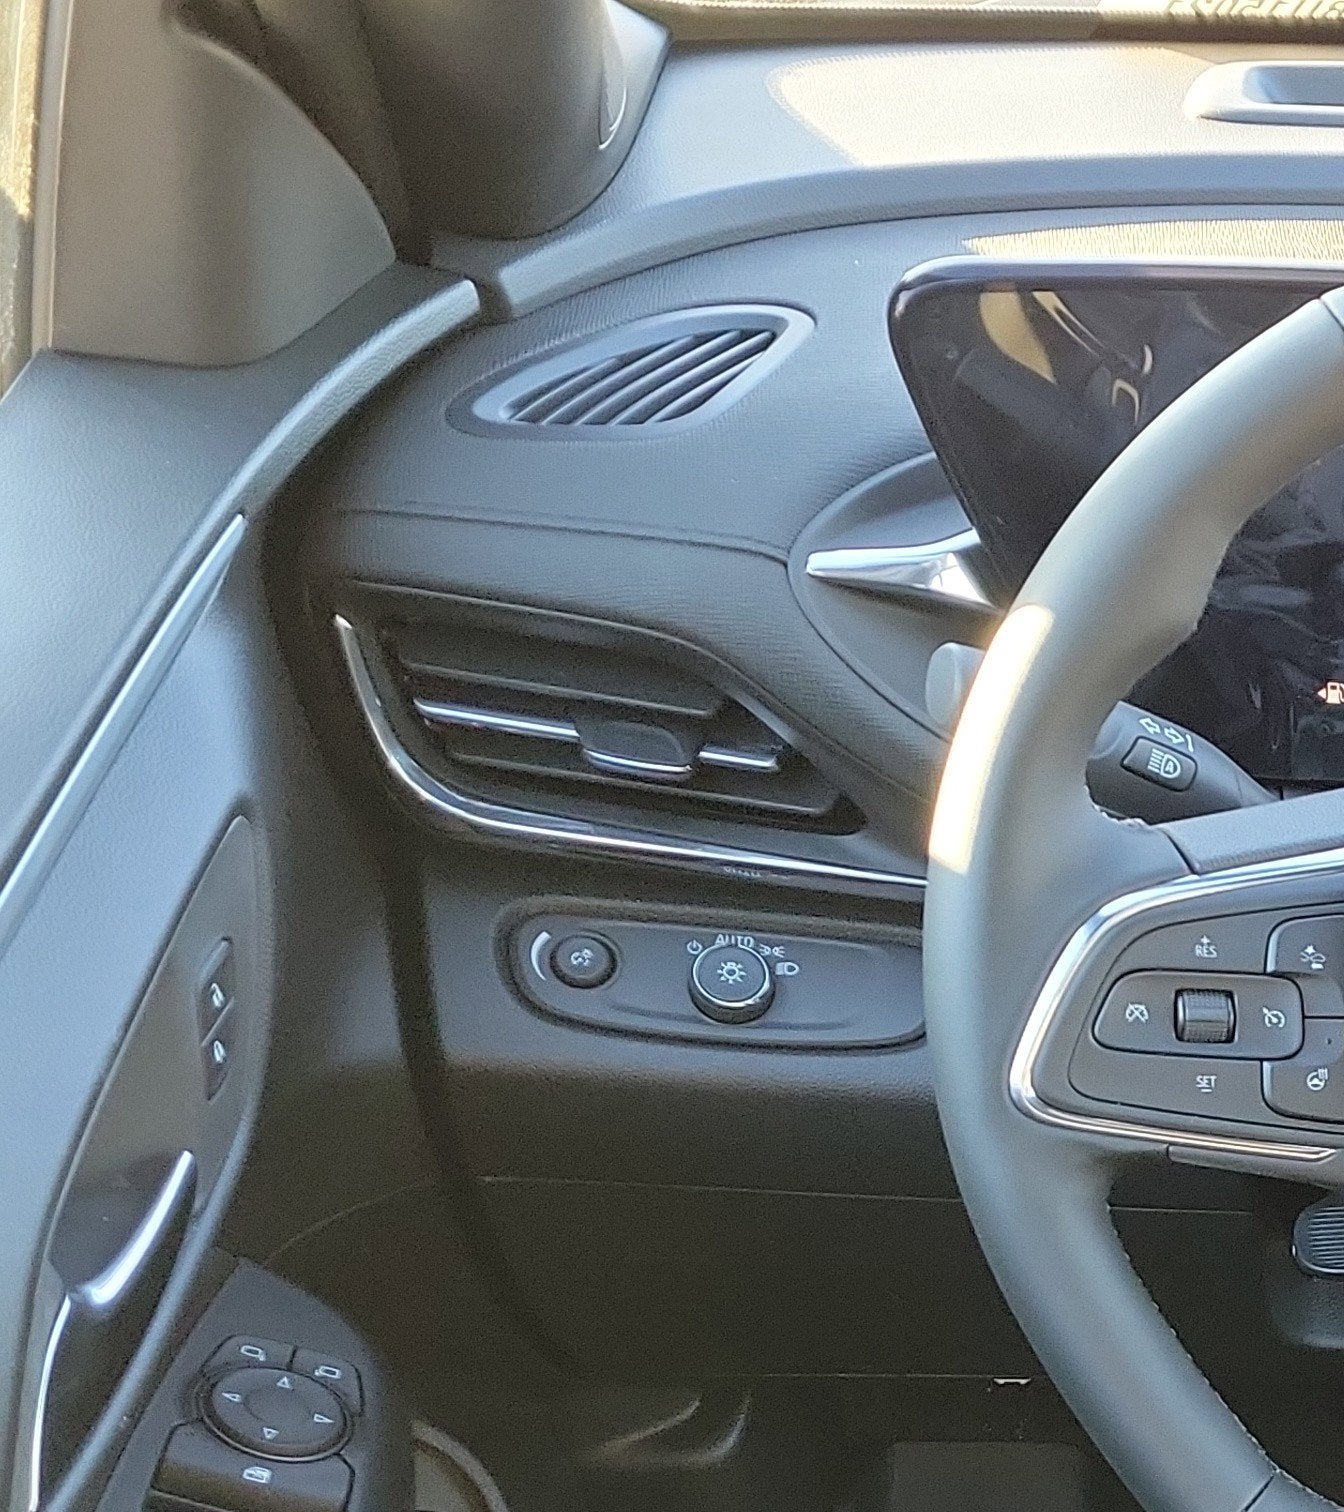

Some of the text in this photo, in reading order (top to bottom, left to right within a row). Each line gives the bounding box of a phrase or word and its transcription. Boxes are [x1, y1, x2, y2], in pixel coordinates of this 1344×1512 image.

[715, 933, 755, 949] AUTO
[1195, 943, 1218, 958] RES
[1196, 1074, 1218, 1089] SET
